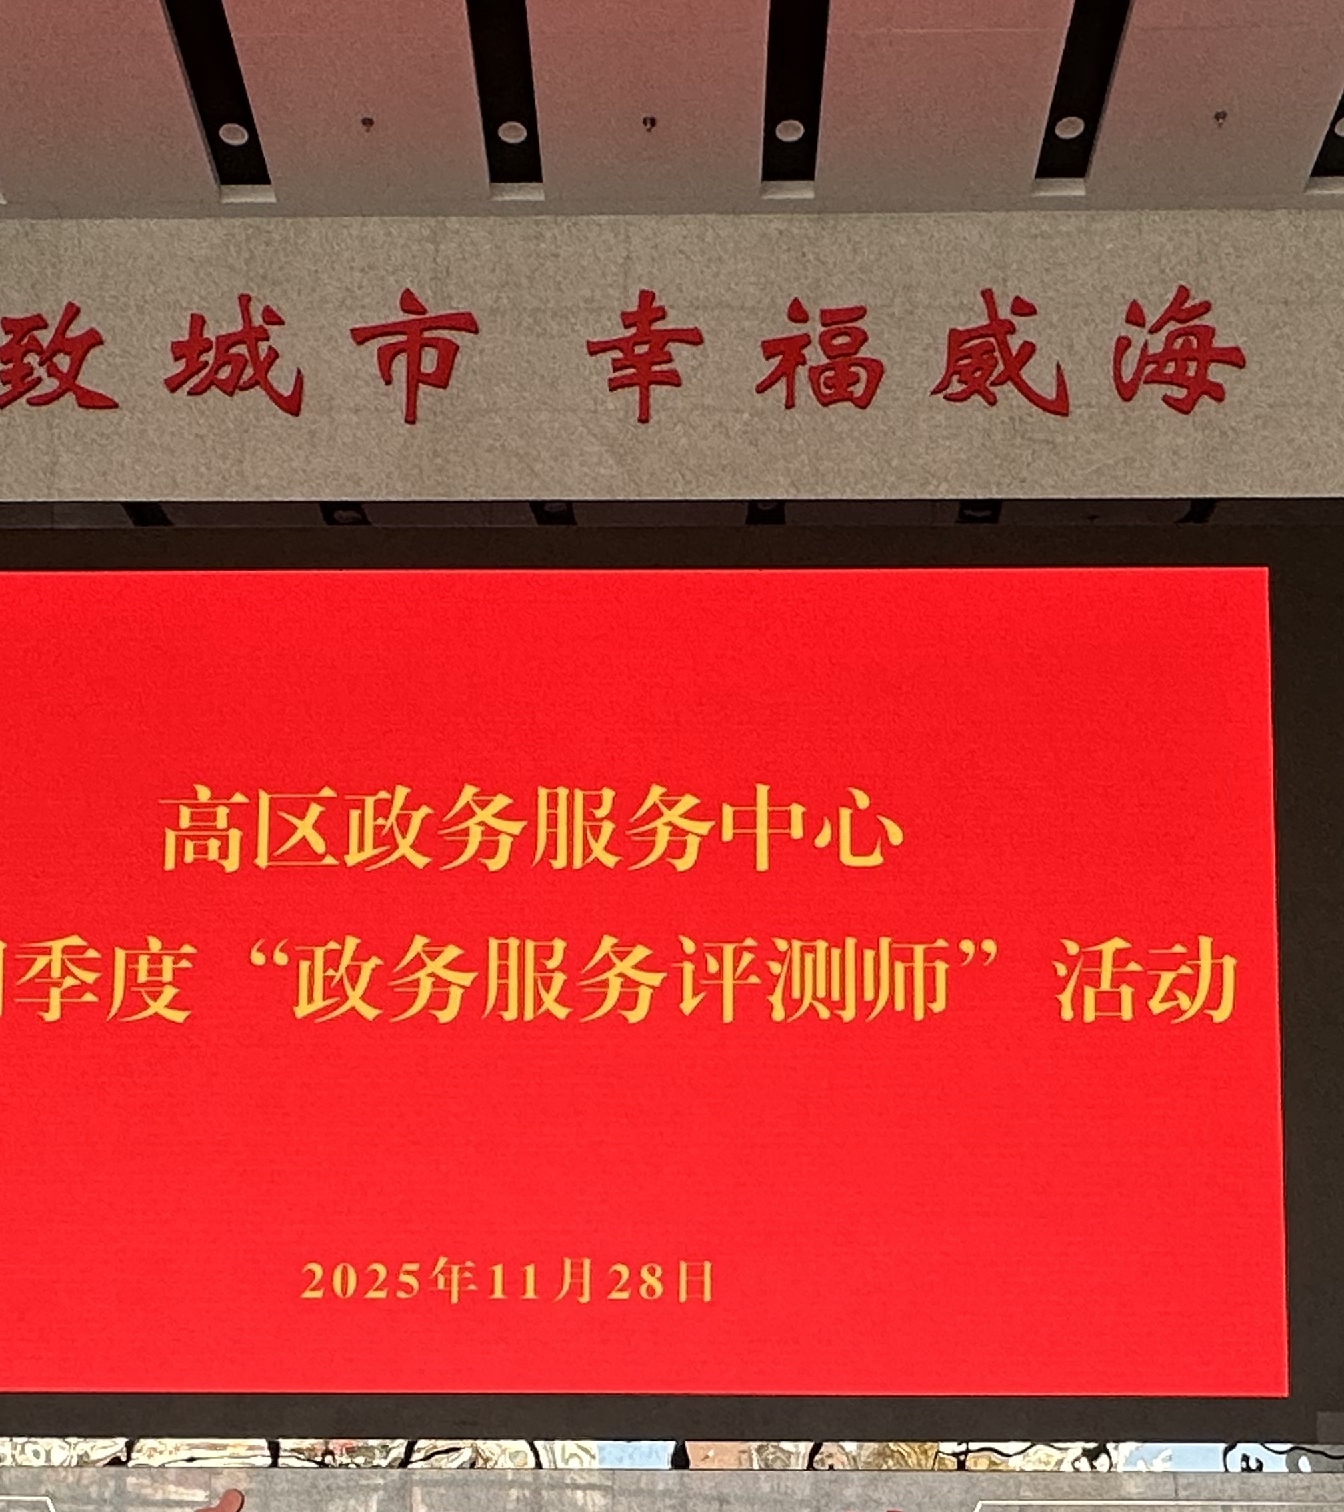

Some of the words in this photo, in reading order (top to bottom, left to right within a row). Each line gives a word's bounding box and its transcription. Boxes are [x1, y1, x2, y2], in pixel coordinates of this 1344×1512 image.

[584, 285, 1247, 424] 幸福威海
[159, 782, 905, 874] 高区政务服务中心
[300, 1256, 714, 1305] 2025年11月28日
